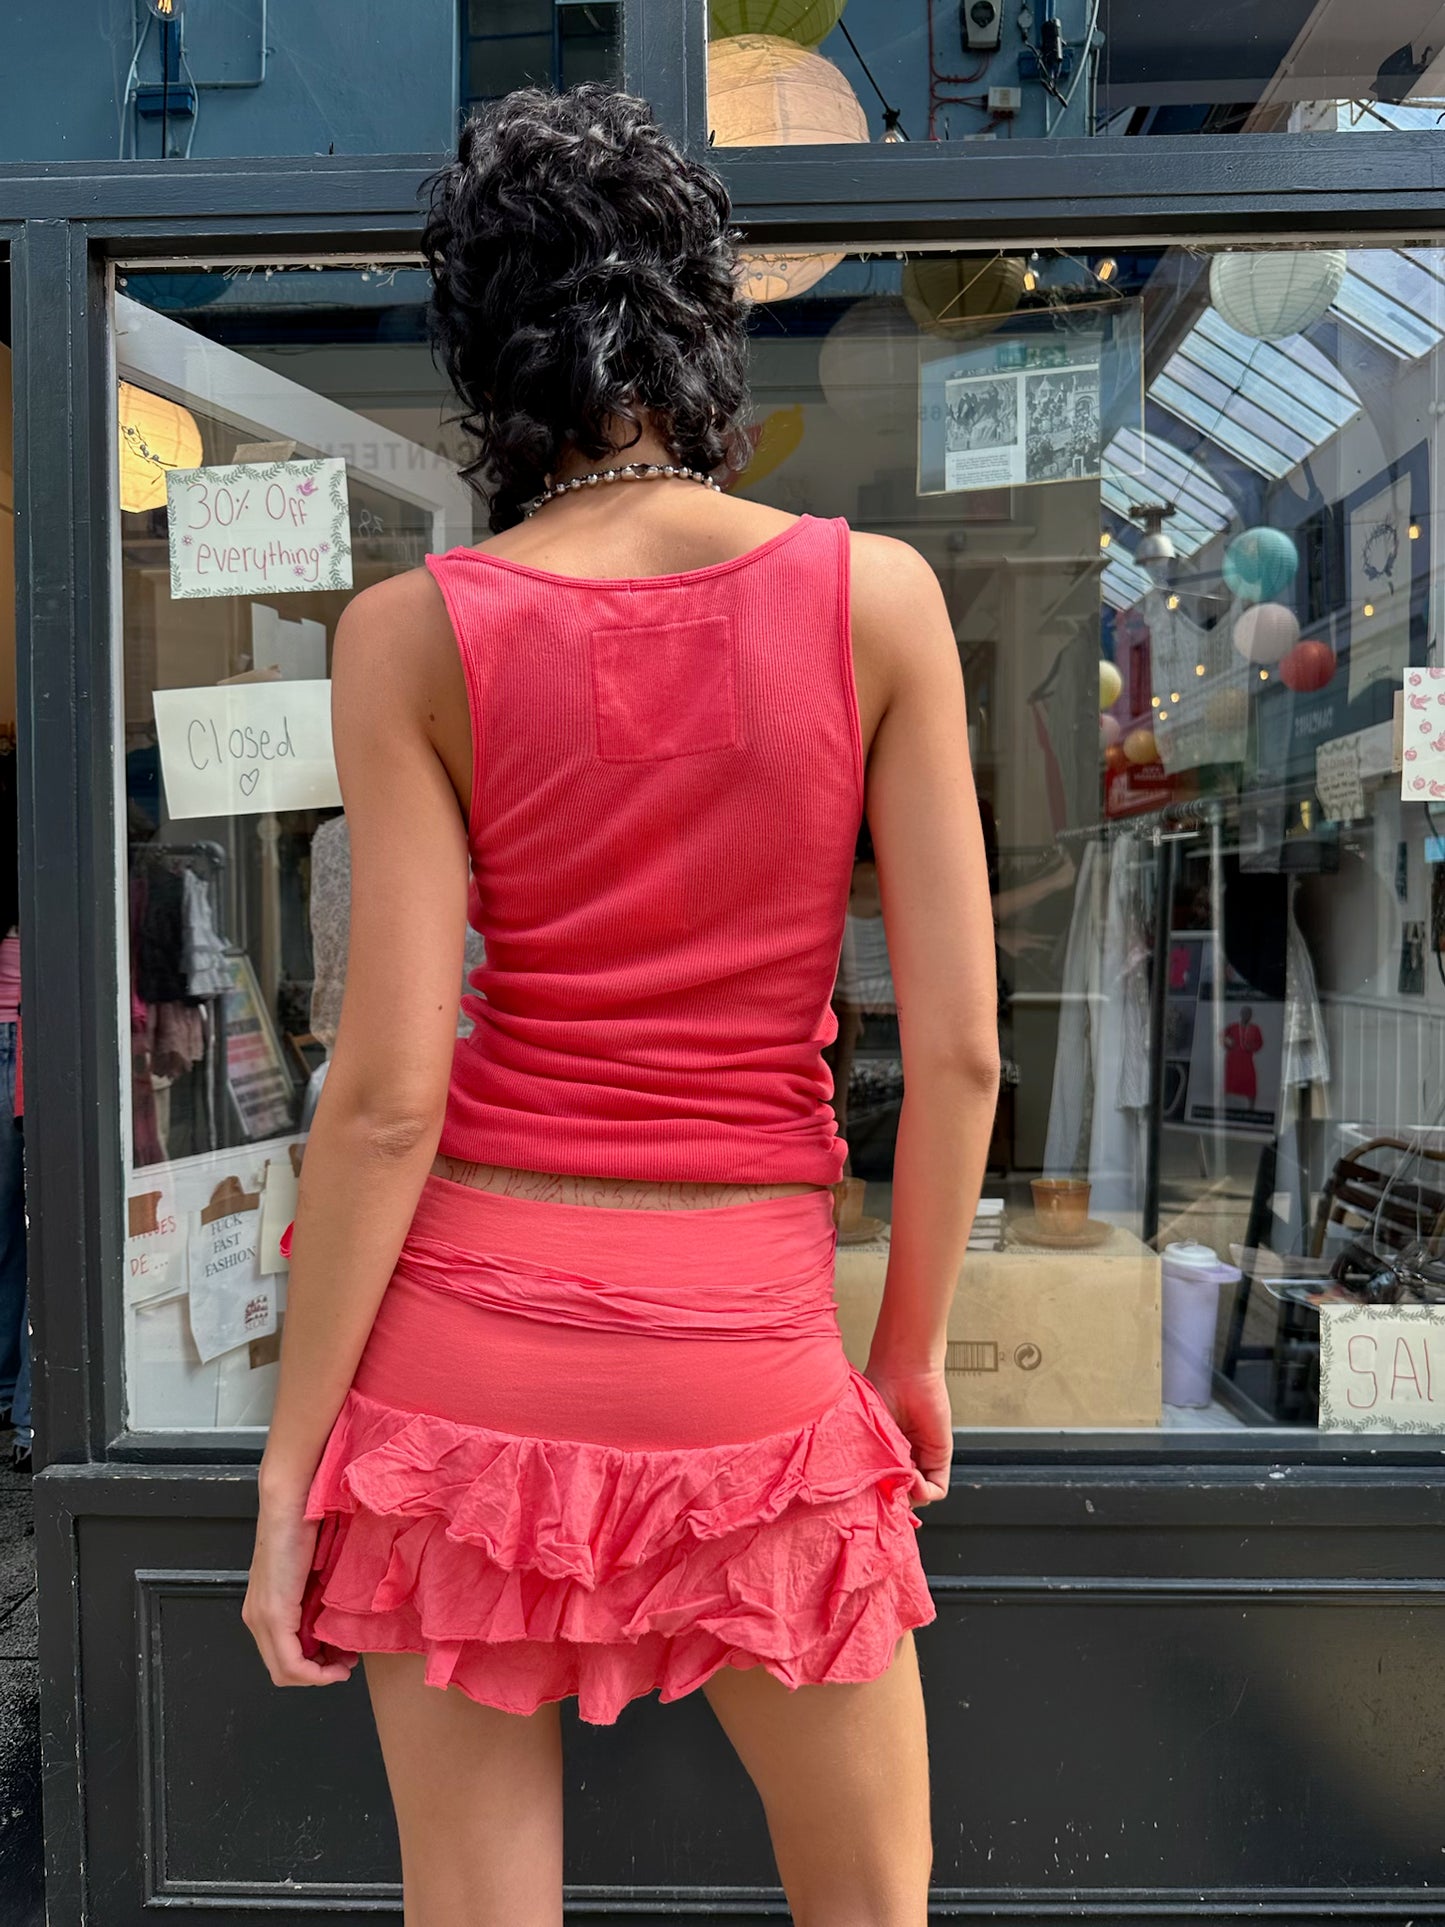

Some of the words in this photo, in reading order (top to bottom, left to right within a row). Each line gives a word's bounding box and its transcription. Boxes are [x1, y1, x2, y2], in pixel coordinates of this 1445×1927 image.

[186, 483, 250, 530] 30%
[266, 483, 307, 527] Off
[196, 540, 320, 582] everything
[187, 715, 296, 770] Closed
[204, 1245, 257, 1278] FASHION
[213, 1231, 242, 1254] FAST
